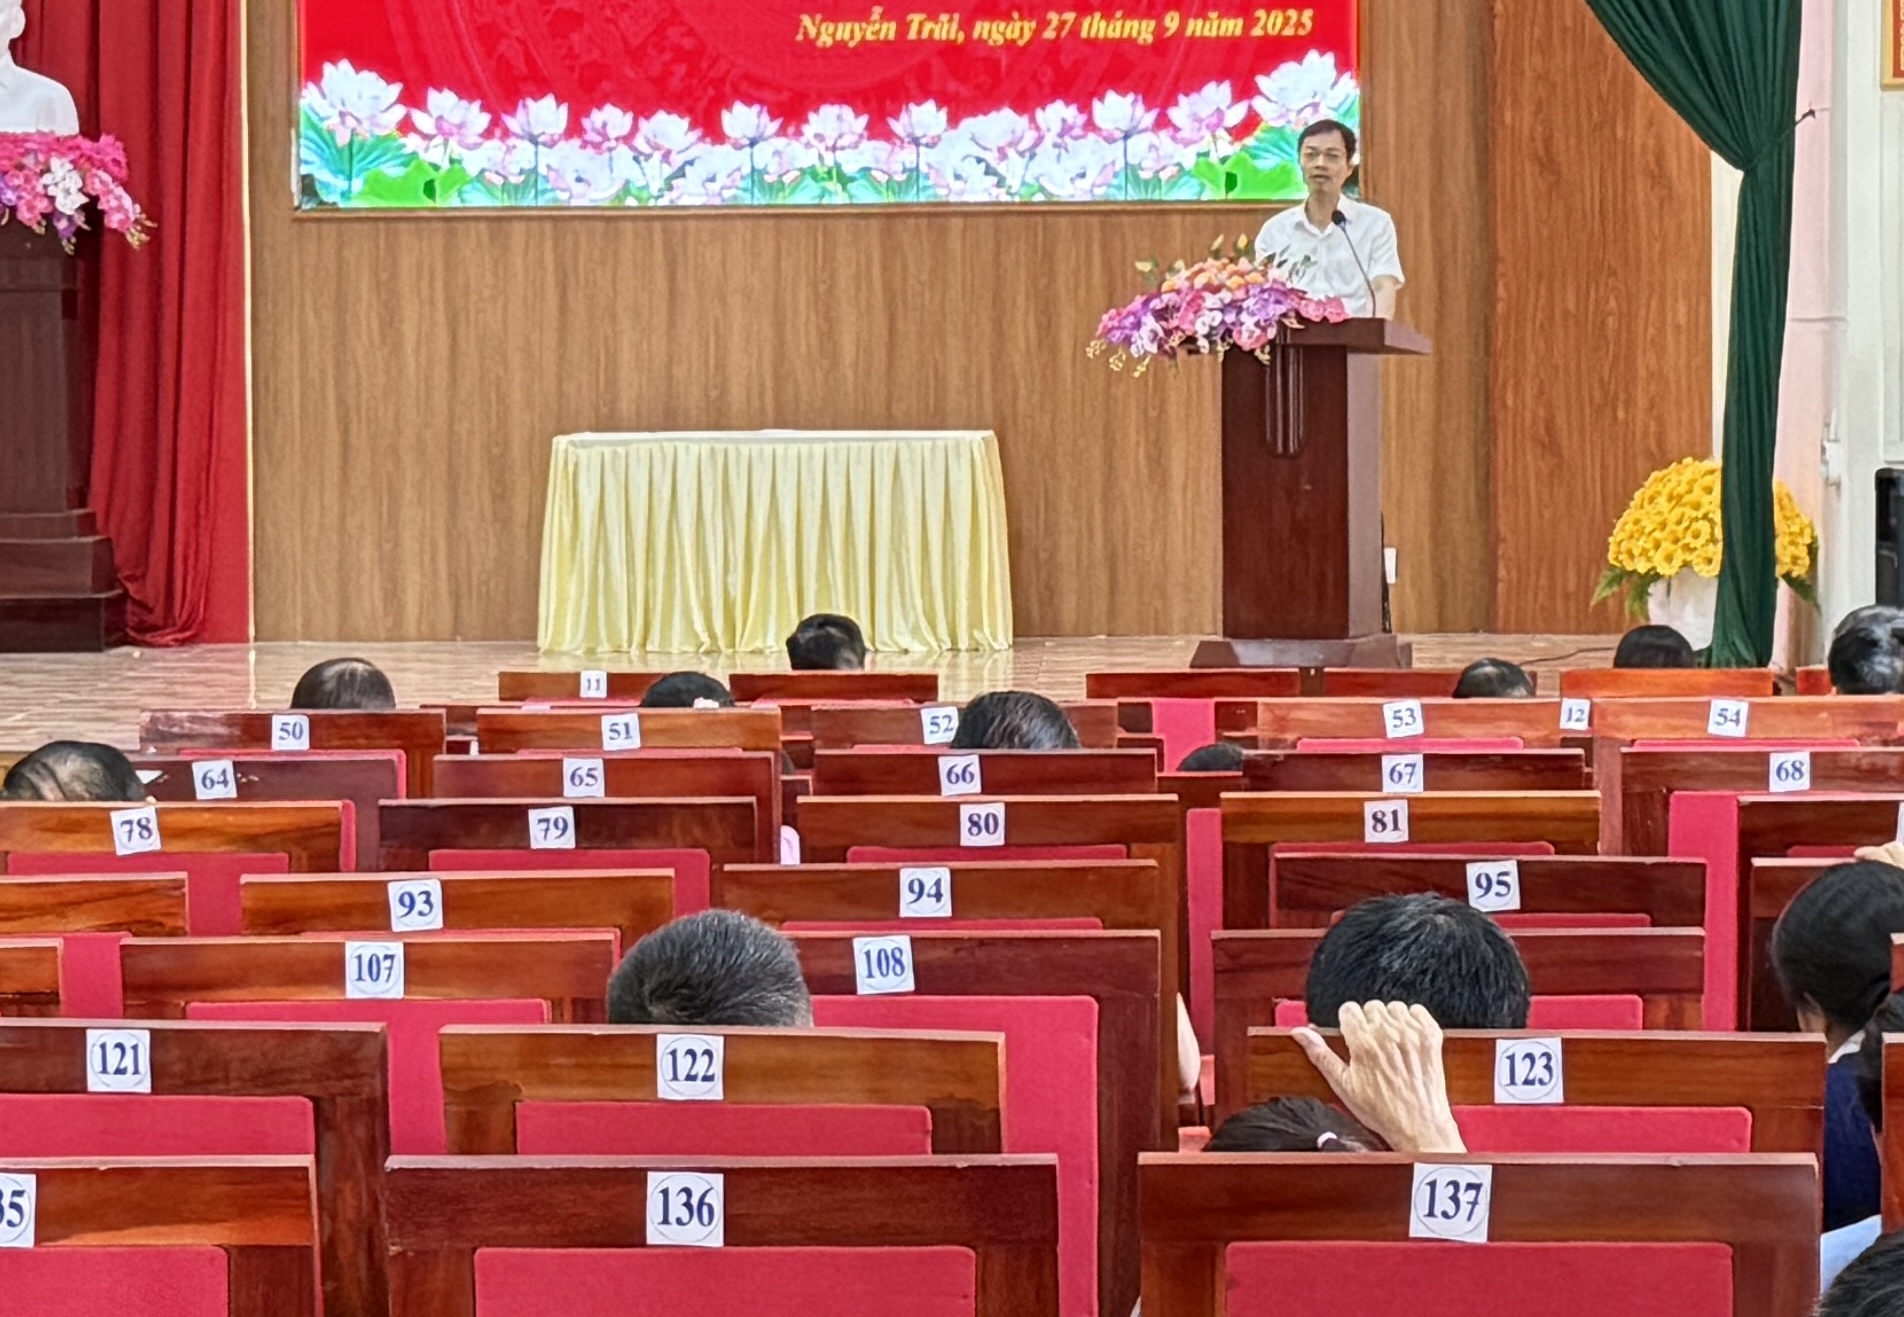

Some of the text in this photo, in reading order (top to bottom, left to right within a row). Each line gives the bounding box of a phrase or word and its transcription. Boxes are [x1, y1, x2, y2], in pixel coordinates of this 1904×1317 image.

[796, 6, 1313, 47] Nguyễn Trãi, ngày 27 tháng 9 năm 2025
[587, 678, 600, 691] 11
[930, 715, 953, 734] 52
[1393, 708, 1416, 728] 53
[1715, 708, 1740, 726] 54
[279, 722, 303, 740] 50
[609, 723, 632, 740] 51
[202, 769, 228, 789] 64
[570, 767, 597, 786] 65
[946, 763, 974, 784] 66
[1389, 763, 1416, 783] 67
[1776, 761, 1804, 780] 68
[121, 817, 152, 841] 78
[538, 817, 568, 840] 79
[968, 813, 998, 835] 80
[1372, 810, 1400, 832] 81
[908, 878, 943, 903] 94
[1476, 871, 1510, 898] 95
[399, 891, 433, 917] 93
[356, 954, 395, 982] 107
[865, 947, 905, 978] 108
[99, 1042, 140, 1075] 121
[669, 1049, 715, 1082] 122
[1506, 1052, 1553, 1086] 123
[659, 1187, 714, 1226] 136
[1424, 1179, 1483, 1221] 137
